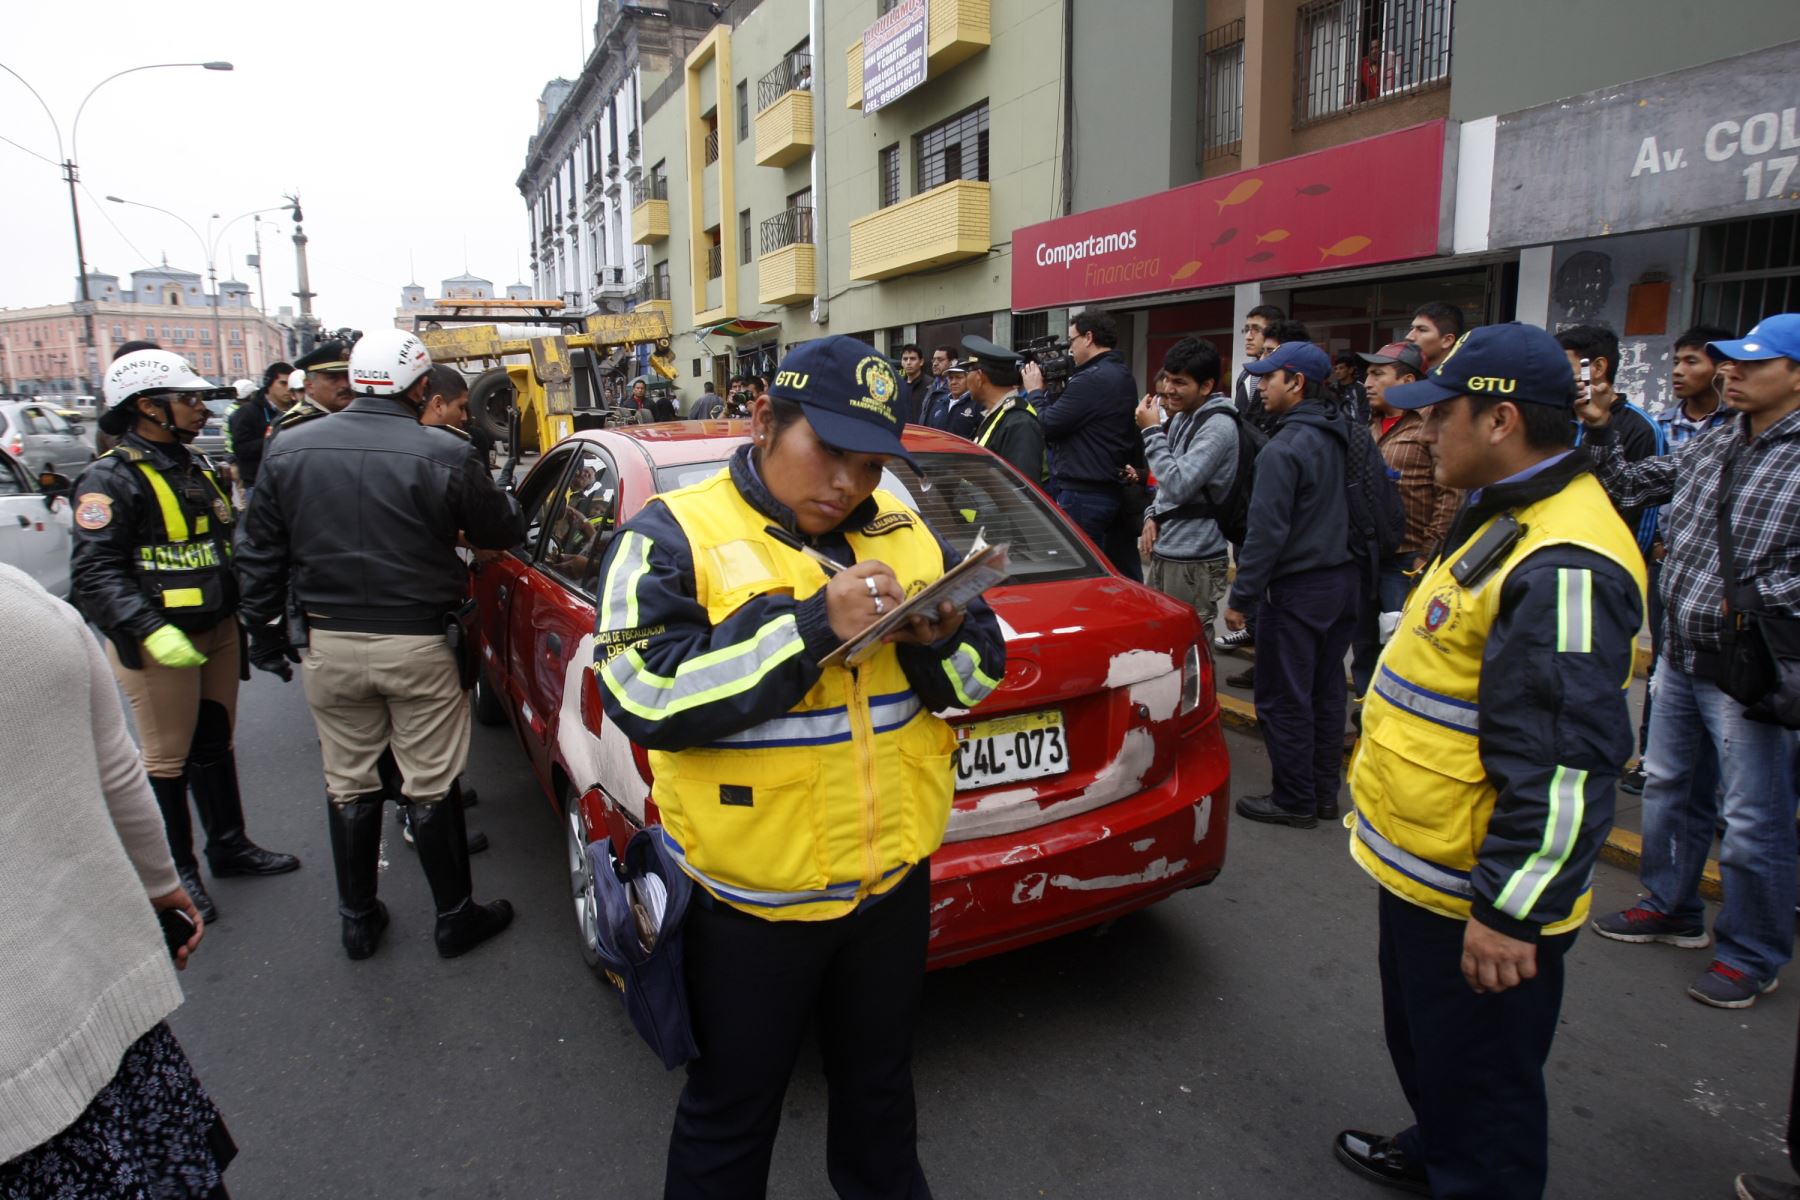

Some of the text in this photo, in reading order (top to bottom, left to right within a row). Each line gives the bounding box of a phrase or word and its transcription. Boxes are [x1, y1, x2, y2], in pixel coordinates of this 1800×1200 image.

[876, 21, 923, 61] DEPARTAMENTOS
[881, 44, 907, 68] CUARTOS
[881, 64, 895, 81] LOCAL
[895, 46, 922, 72] COMERCIAL
[865, 98, 879, 113] CEL:
[1630, 136, 1688, 178] Av.
[1743, 155, 1799, 200] 17
[1036, 229, 1137, 269] Compartamos
[1085, 256, 1160, 287] Financiera
[111, 360, 170, 383] TRANSITO
[353, 368, 390, 379] POLICIA
[775, 371, 809, 393] GTU
[1467, 376, 1517, 393] GTU
[141, 543, 216, 571] POLICIA
[612, 631, 621, 642] DE
[957, 726, 1063, 780] C4L-073
